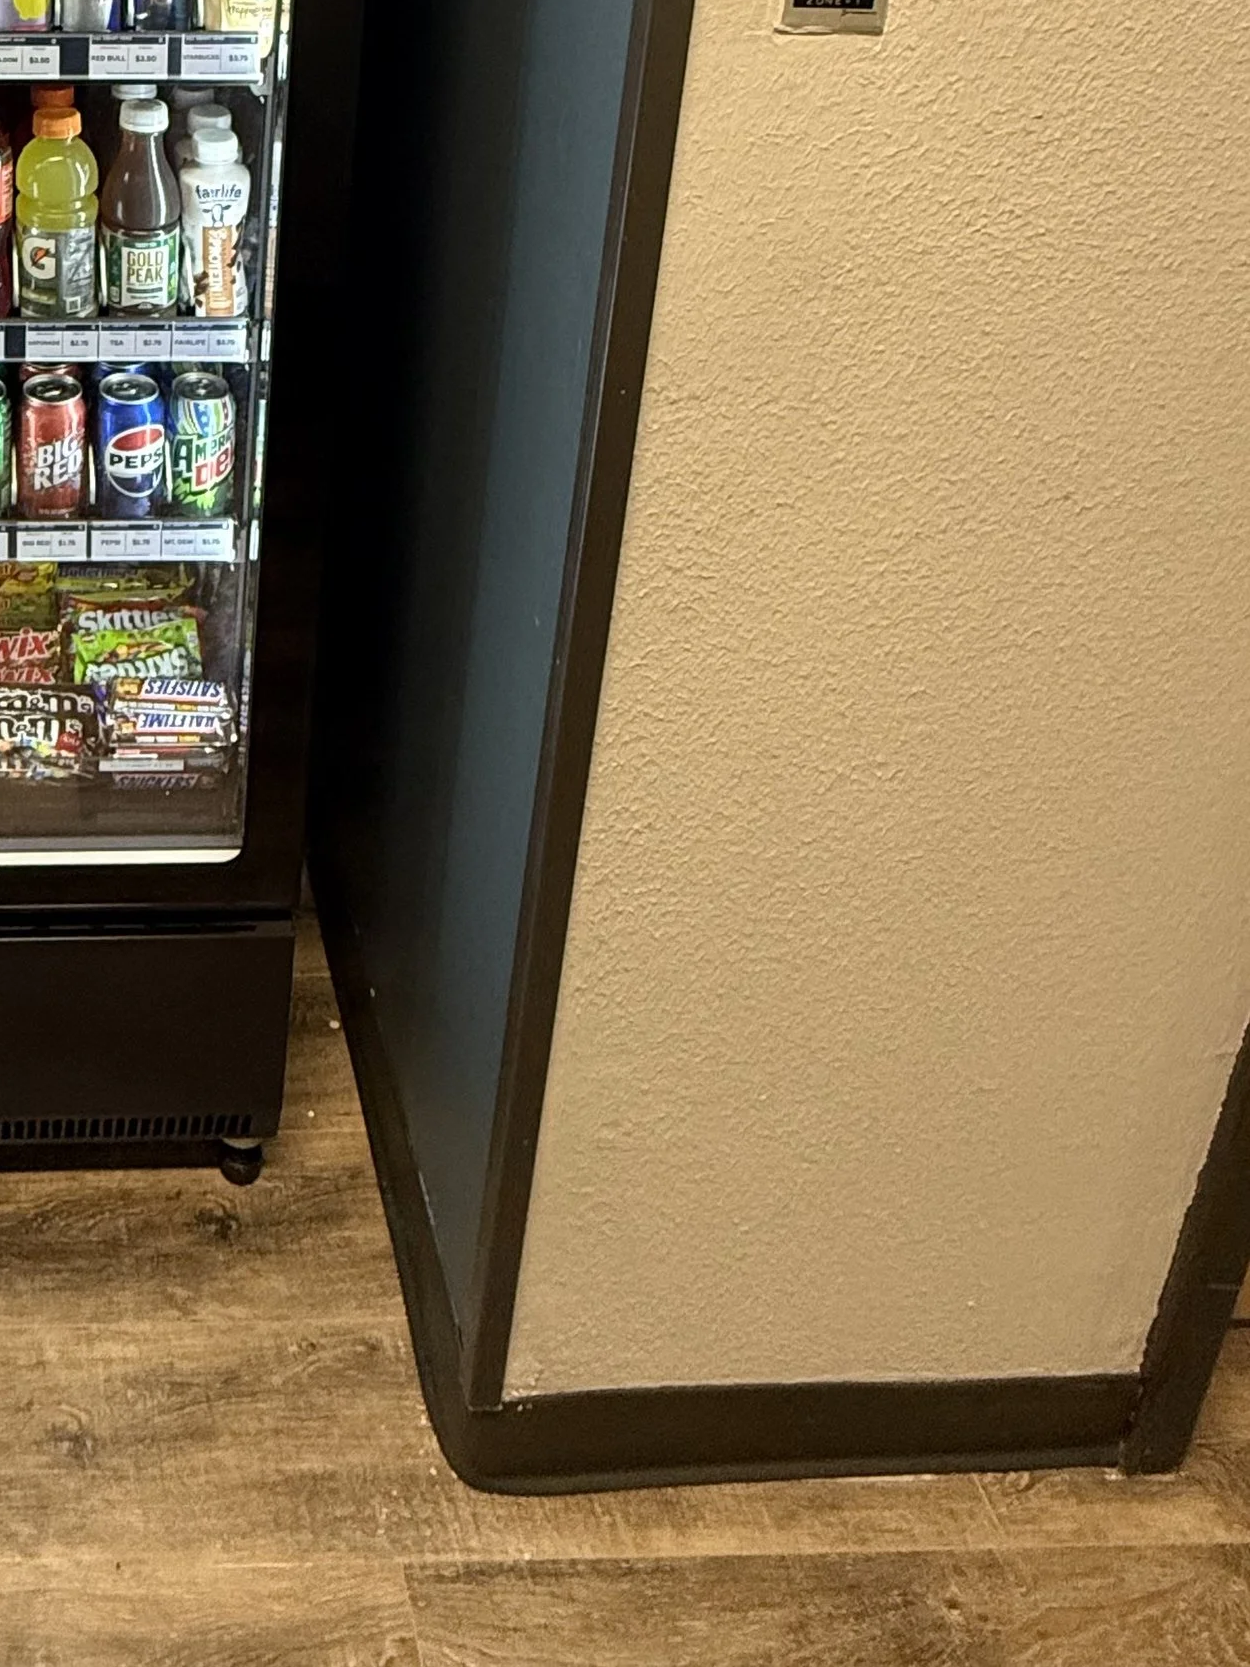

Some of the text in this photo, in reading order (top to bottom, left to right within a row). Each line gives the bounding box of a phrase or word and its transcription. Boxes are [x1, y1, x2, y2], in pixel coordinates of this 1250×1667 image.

[91, 54, 127, 63] RED BULL
[195, 184, 242, 199] fairlife
[126, 250, 165, 268] GOLD
[126, 266, 164, 283] PEAK
[110, 339, 124, 347] TEA
[37, 435, 79, 469] BIG
[33, 447, 83, 491] RED
[78, 608, 183, 636] Skittles
[144, 679, 221, 698] SATISFIES
